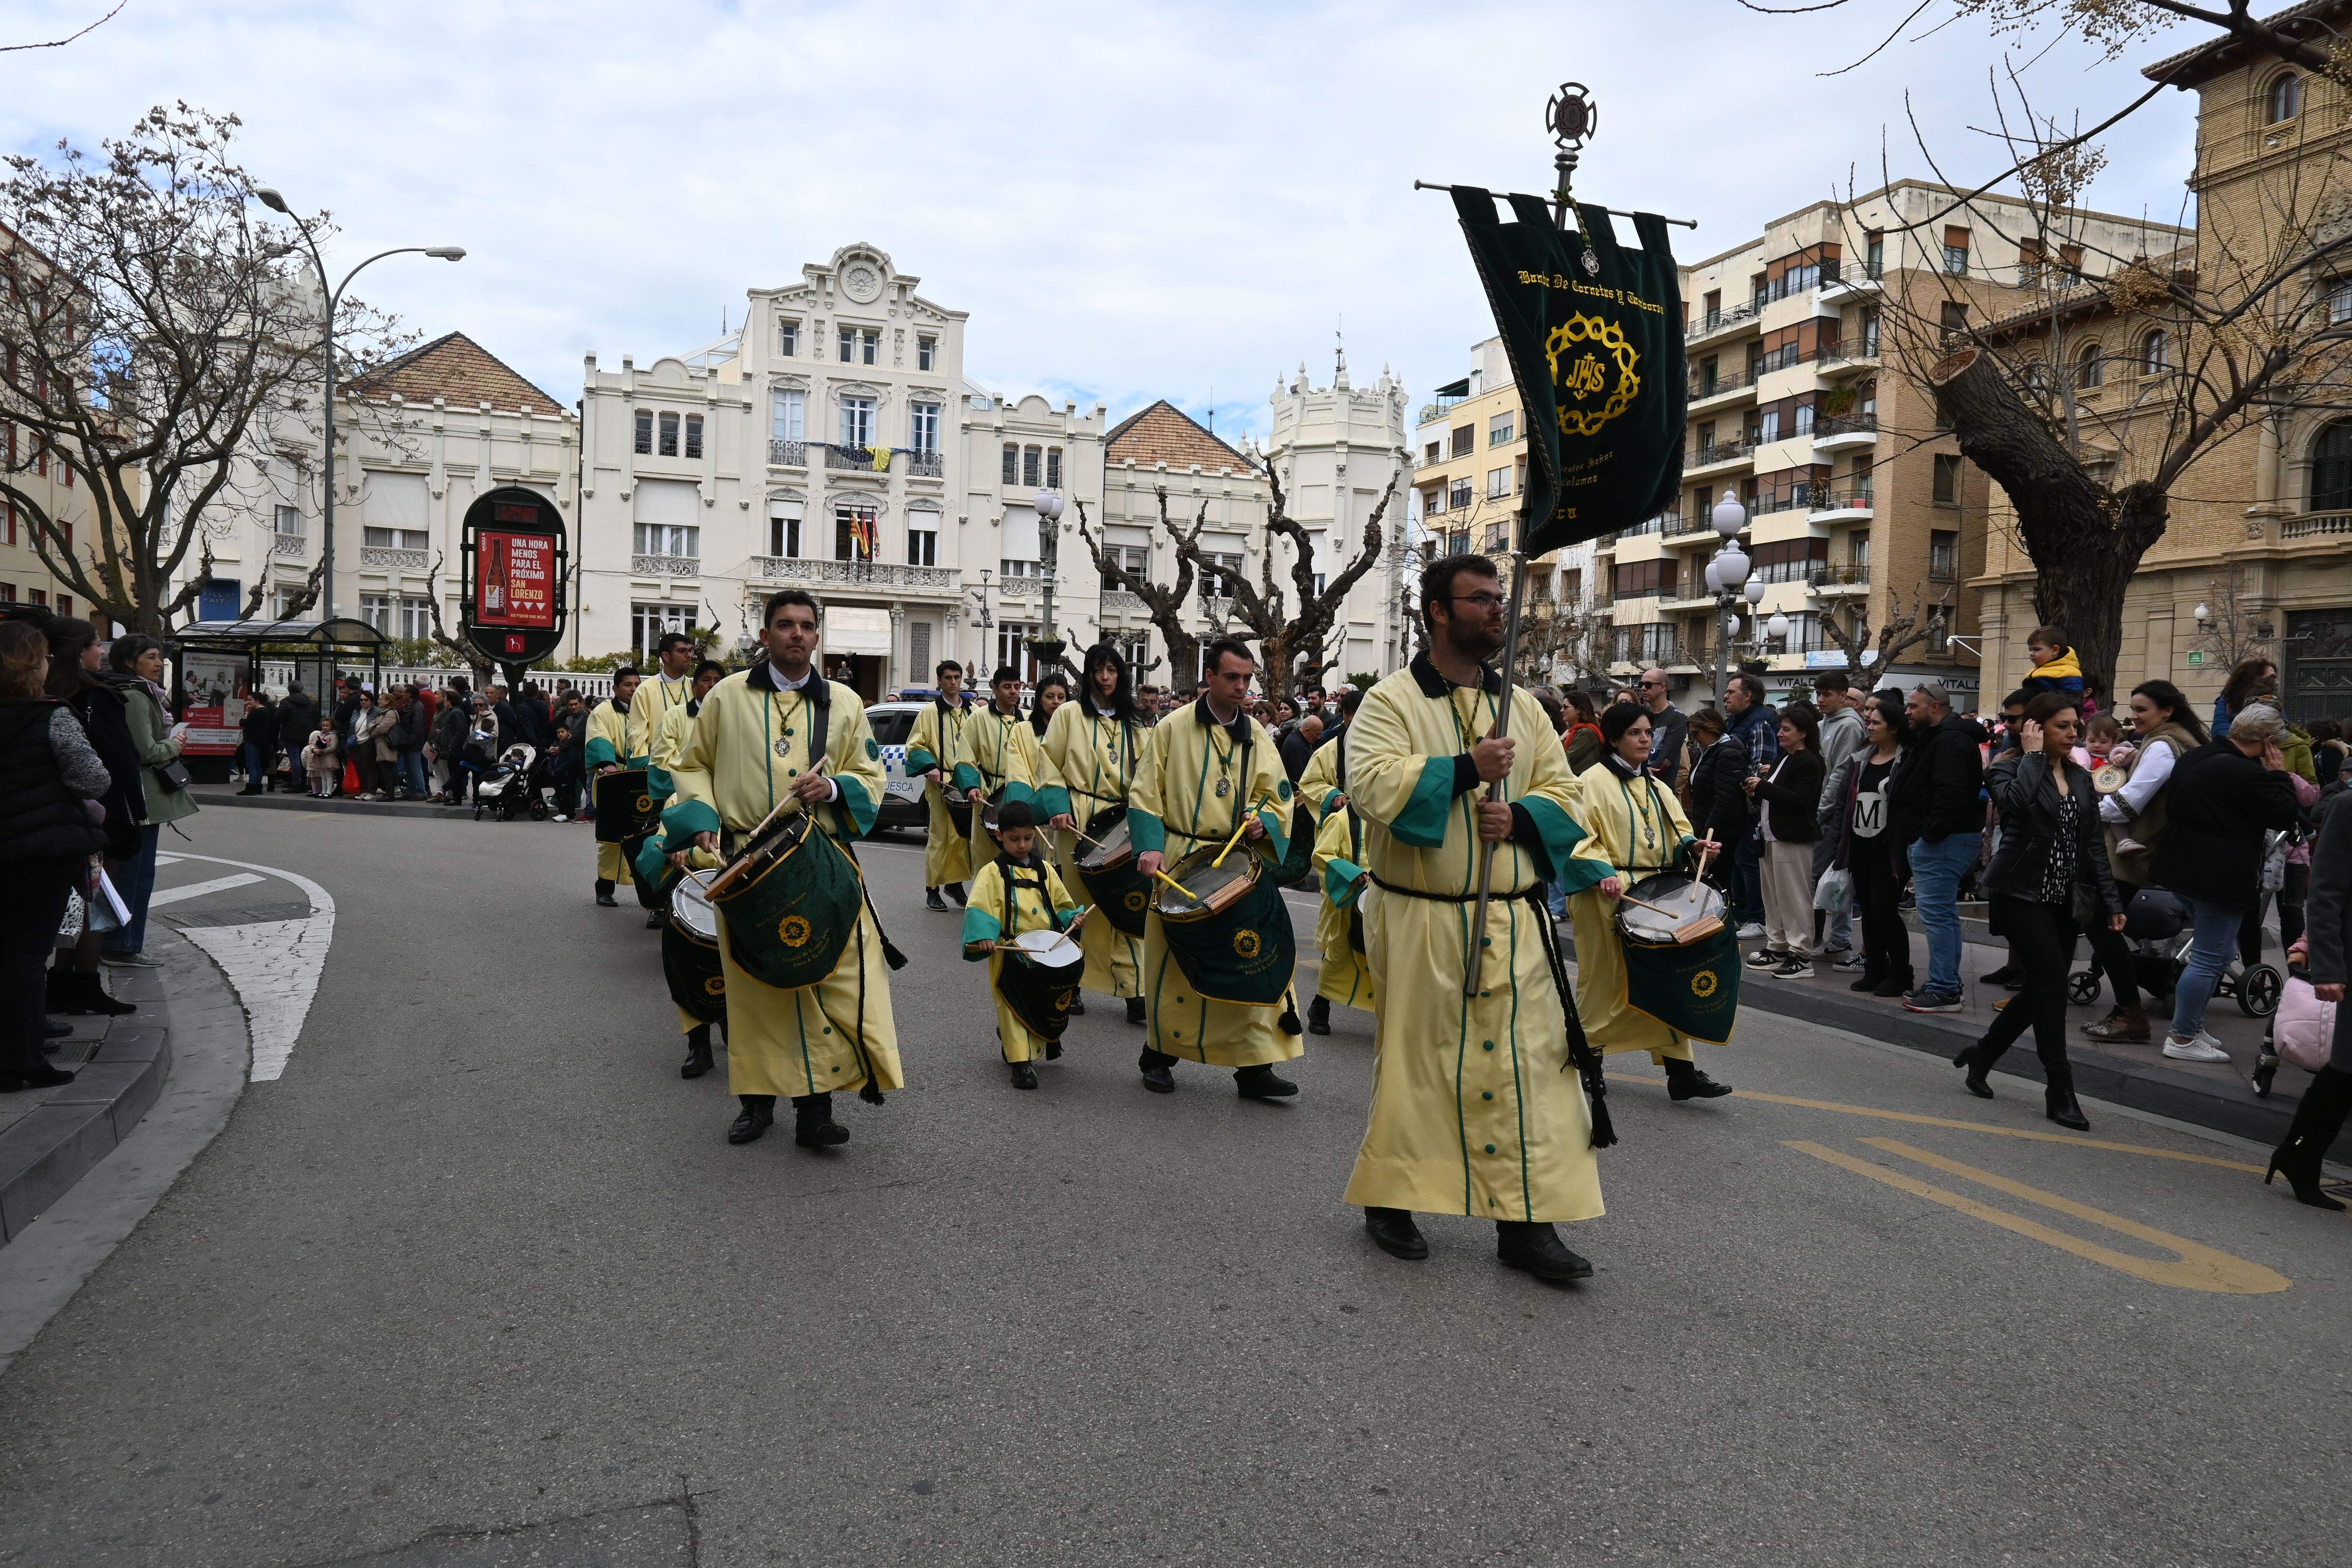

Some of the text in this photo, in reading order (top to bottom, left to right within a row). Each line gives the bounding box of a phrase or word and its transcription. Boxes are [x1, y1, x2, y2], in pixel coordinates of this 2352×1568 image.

[1517, 270, 1664, 315] Banda De Cornetas Y Tambores
[1587, 450, 1613, 470] Señor
[511, 538, 549, 550] UNA HORA
[511, 548, 538, 559] MENOS
[511, 558, 542, 570] PARA EL
[511, 568, 544, 580] PRÓXIMO
[511, 579, 526, 589] SAN
[511, 588, 543, 600] LORENZO
[885, 781, 914, 792] UESCA
[1854, 800, 1881, 829] M
